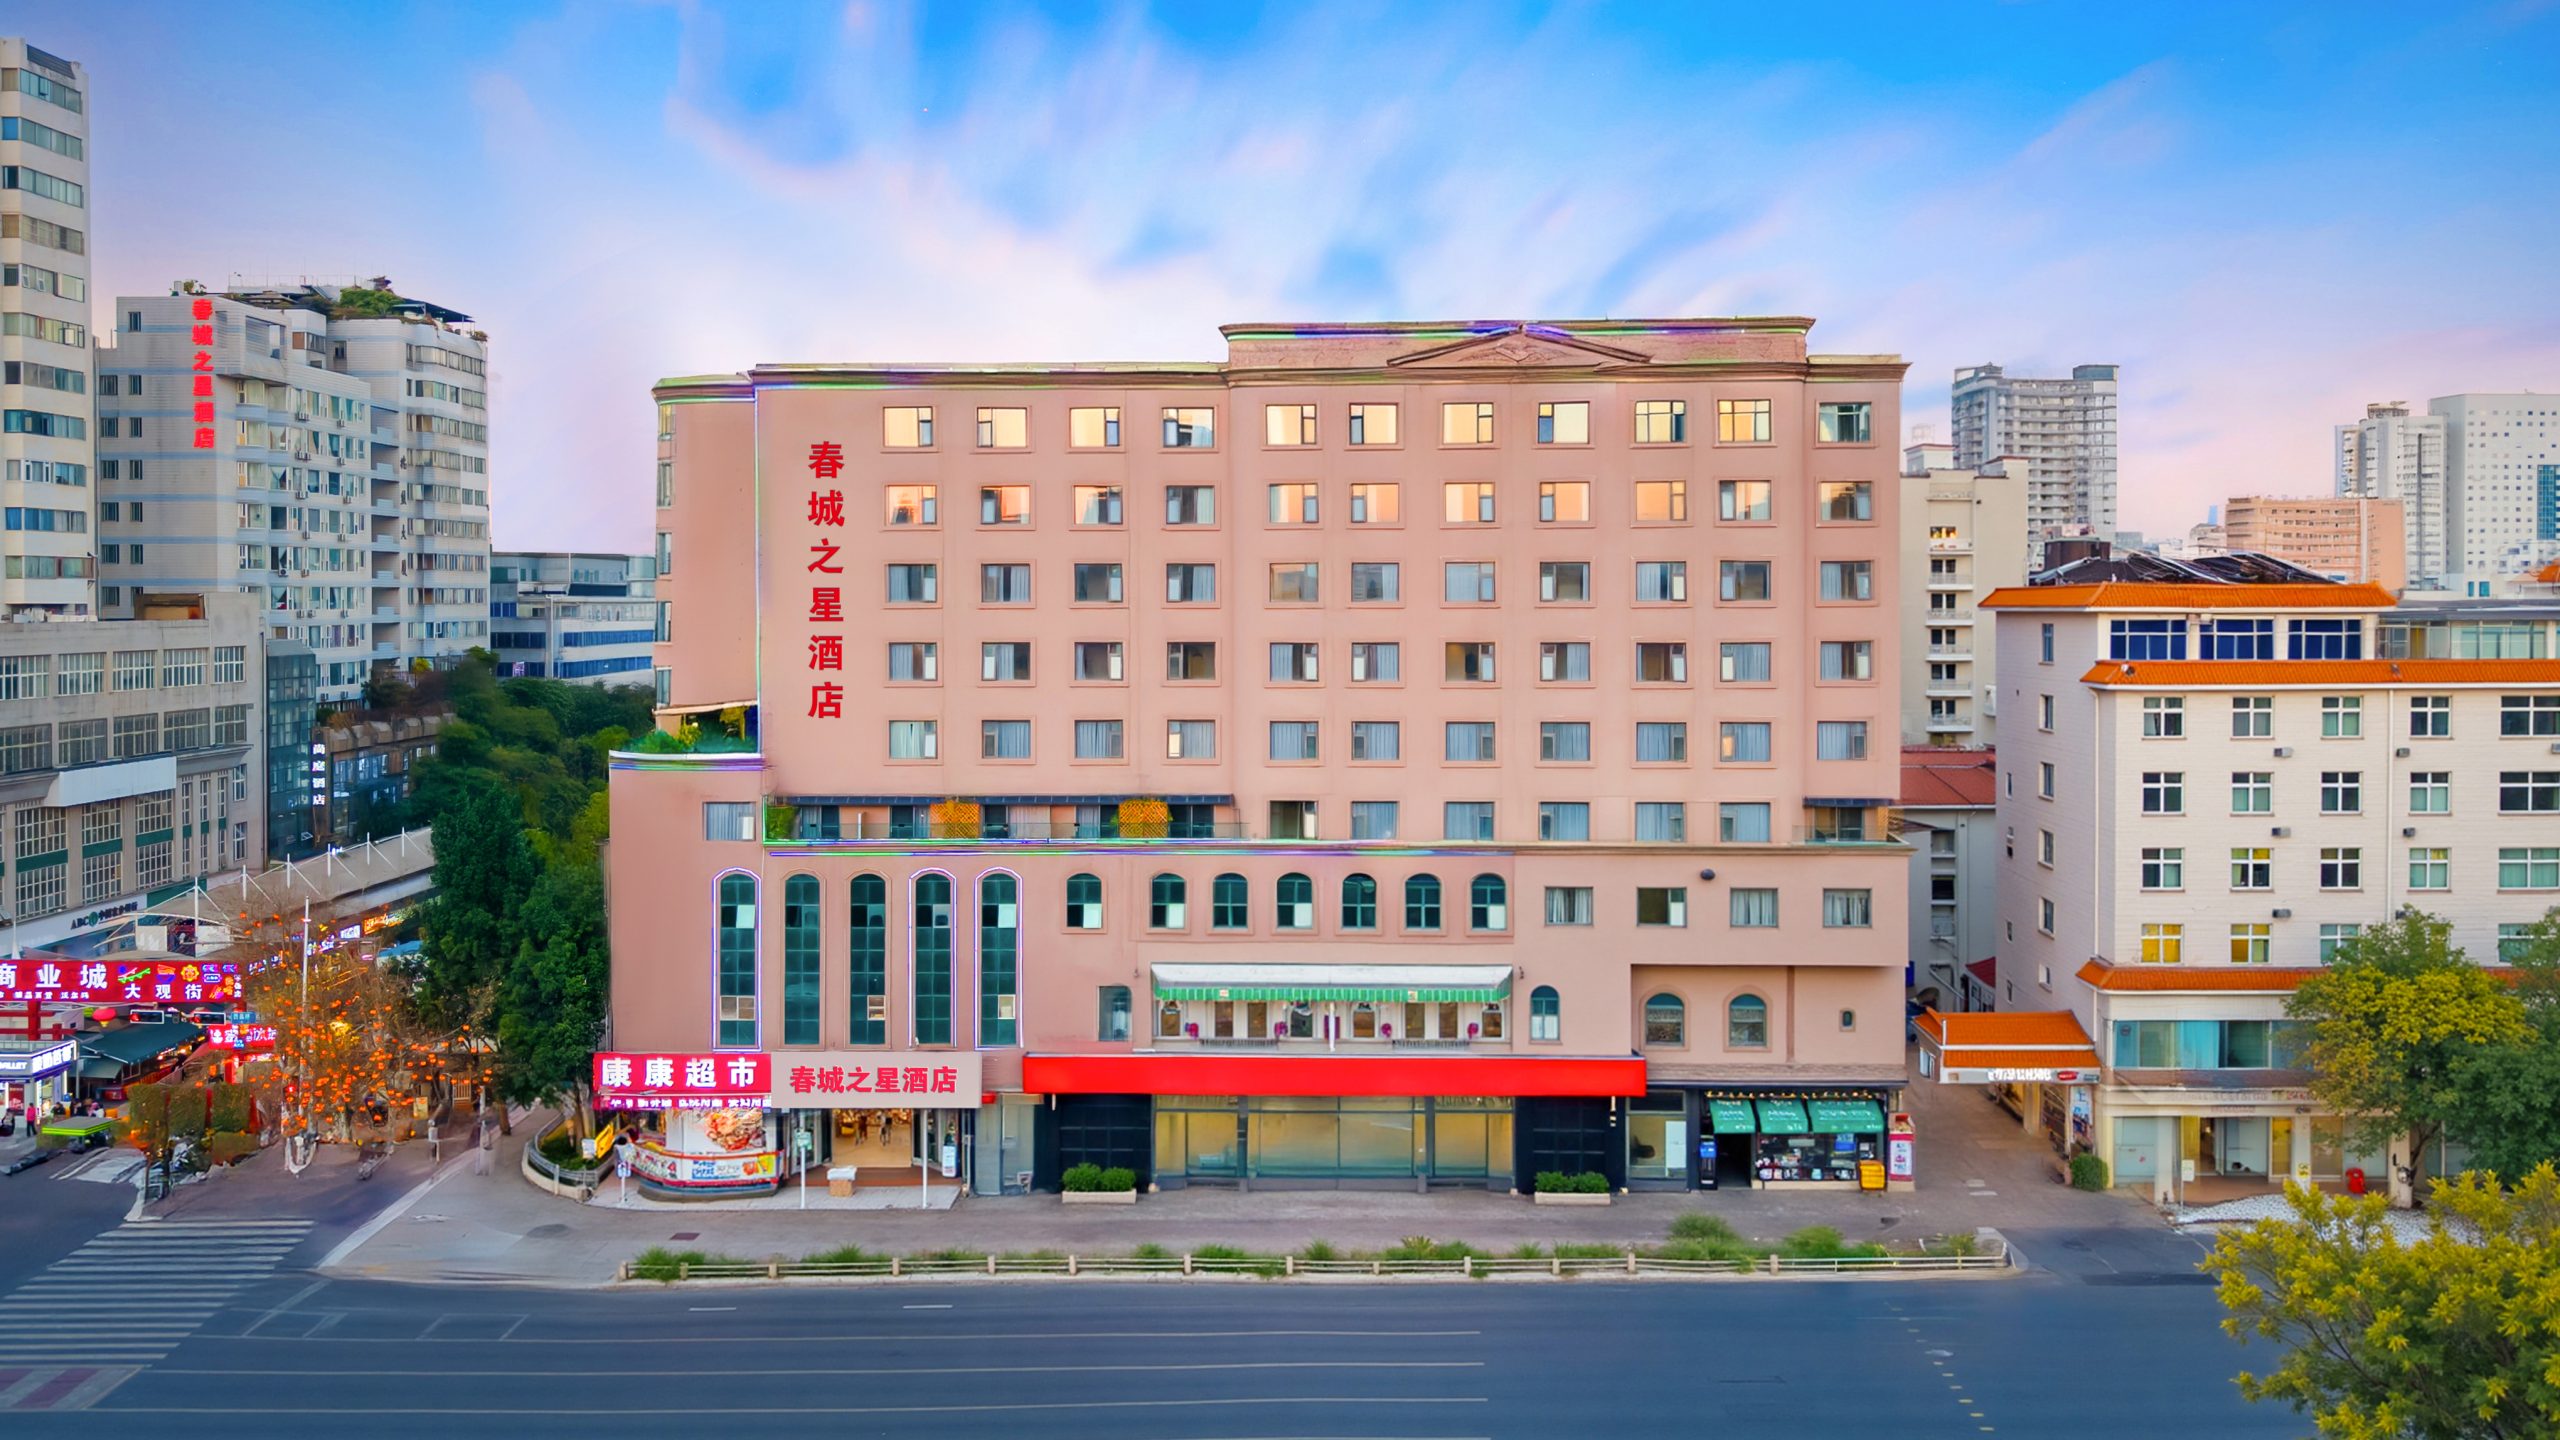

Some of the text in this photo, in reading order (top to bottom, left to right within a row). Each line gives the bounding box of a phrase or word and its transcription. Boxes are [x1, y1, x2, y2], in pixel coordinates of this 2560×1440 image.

[192, 299, 215, 448] 春城之星酒店
[807, 441, 845, 719] 春城之星酒店
[124, 983, 202, 999] 大观街
[601, 1056, 758, 1088] 康康超市
[789, 1065, 958, 1094] 春城之星酒店
